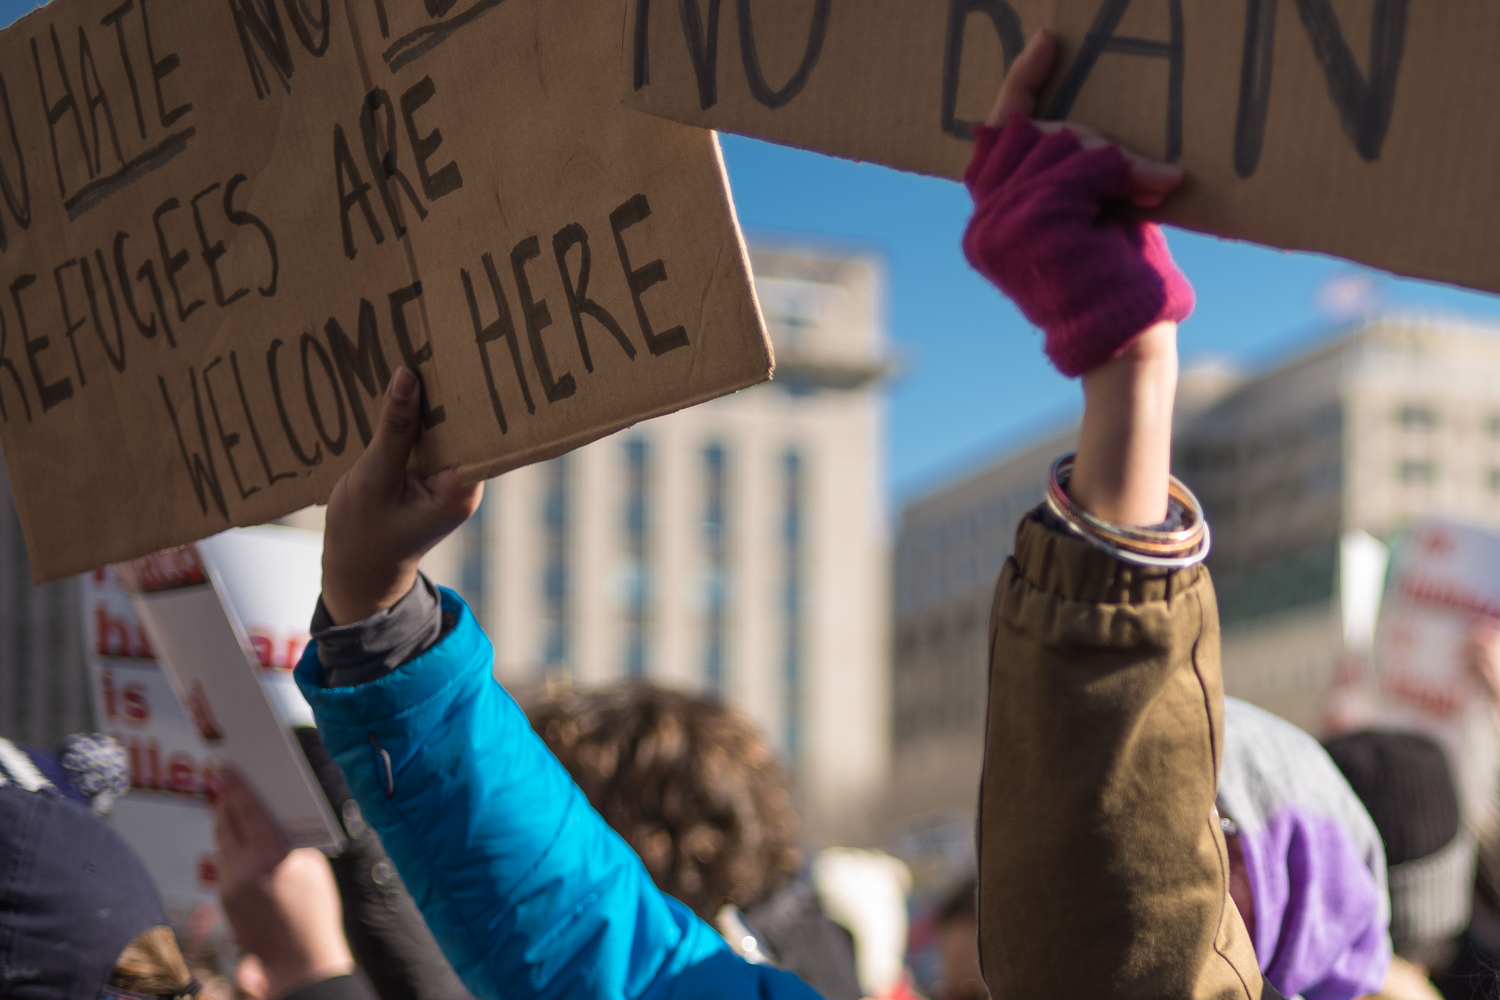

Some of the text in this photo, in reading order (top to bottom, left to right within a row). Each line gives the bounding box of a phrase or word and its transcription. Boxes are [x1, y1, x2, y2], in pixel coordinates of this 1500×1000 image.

[29, 0, 193, 199] HATE
[333, 75, 463, 259] ARE
[157, 193, 690, 523] WELCOME HERE
[103, 664, 149, 731] is
